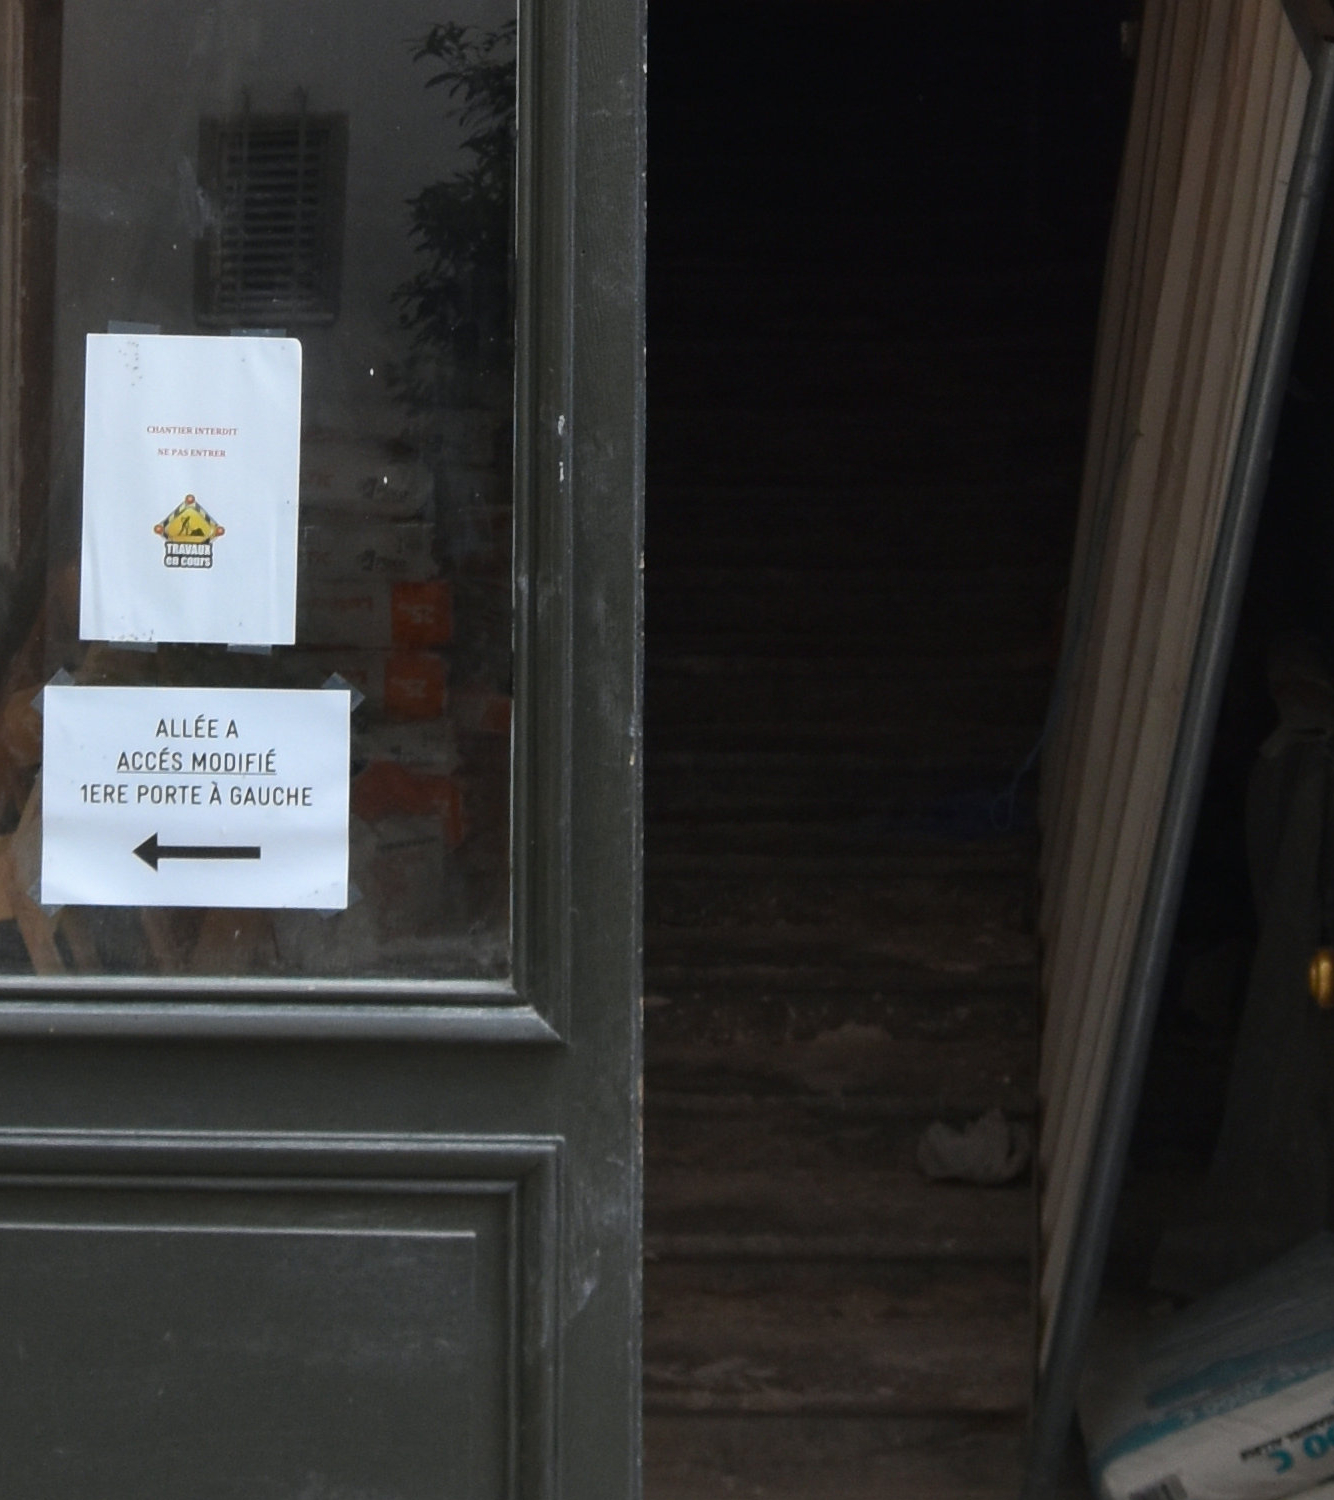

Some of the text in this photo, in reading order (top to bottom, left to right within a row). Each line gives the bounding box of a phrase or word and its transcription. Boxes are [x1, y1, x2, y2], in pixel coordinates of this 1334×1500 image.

[146, 425, 238, 436] CHANTIER INTERDIT
[157, 448, 227, 458] NE PAS ENTRER
[166, 543, 211, 555] TRAVAUX
[155, 713, 239, 739] ALLÉE A
[117, 747, 277, 773] ACCÉS MODIFIÉ
[80, 781, 313, 807] 1ERE PORTE À GAUCHE
